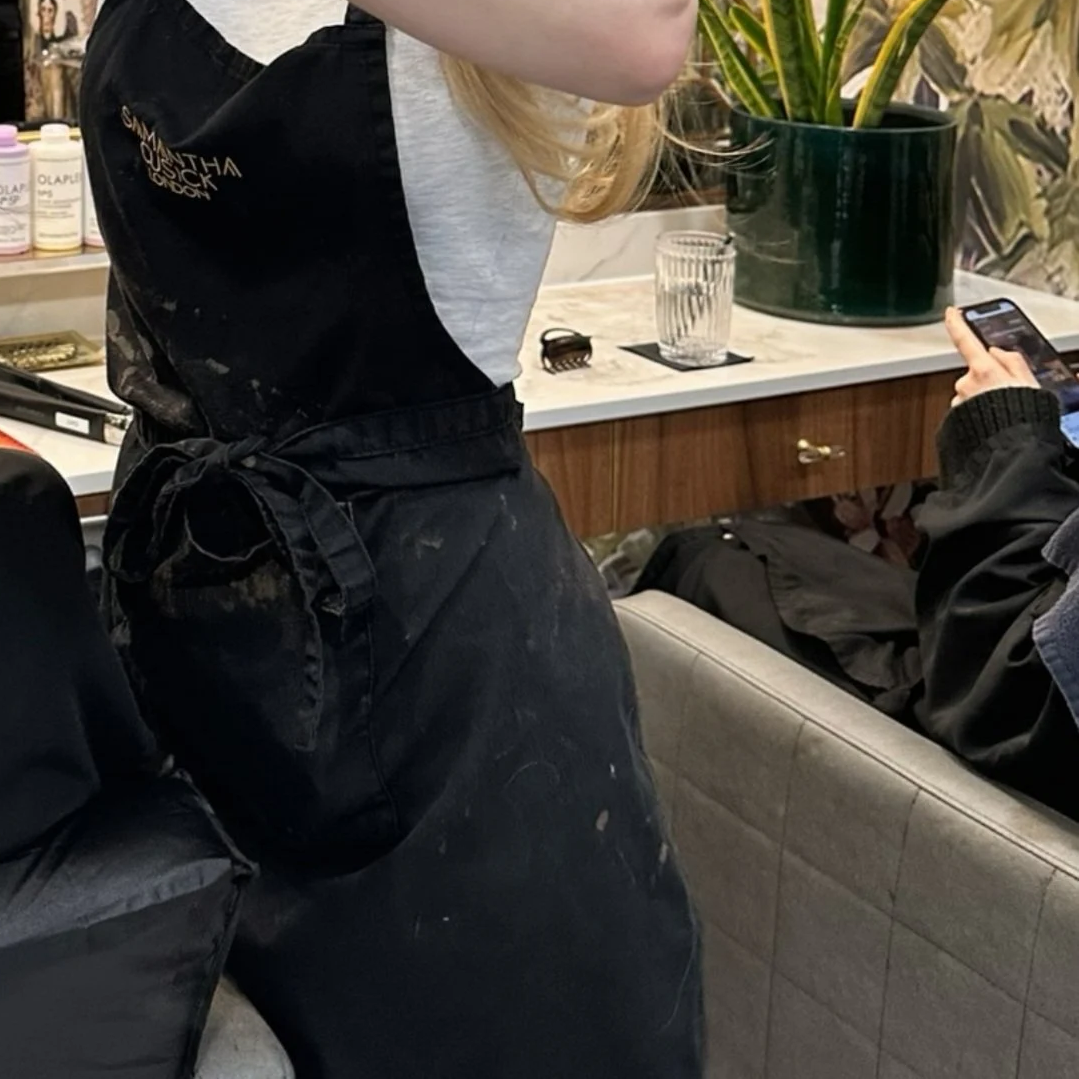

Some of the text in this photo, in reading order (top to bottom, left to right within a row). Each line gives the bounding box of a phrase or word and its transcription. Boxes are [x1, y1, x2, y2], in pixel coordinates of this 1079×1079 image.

[121, 105, 242, 177] SAMANTHA
[140, 141, 218, 191] CUSICK
[148, 167, 211, 200] LONDON
